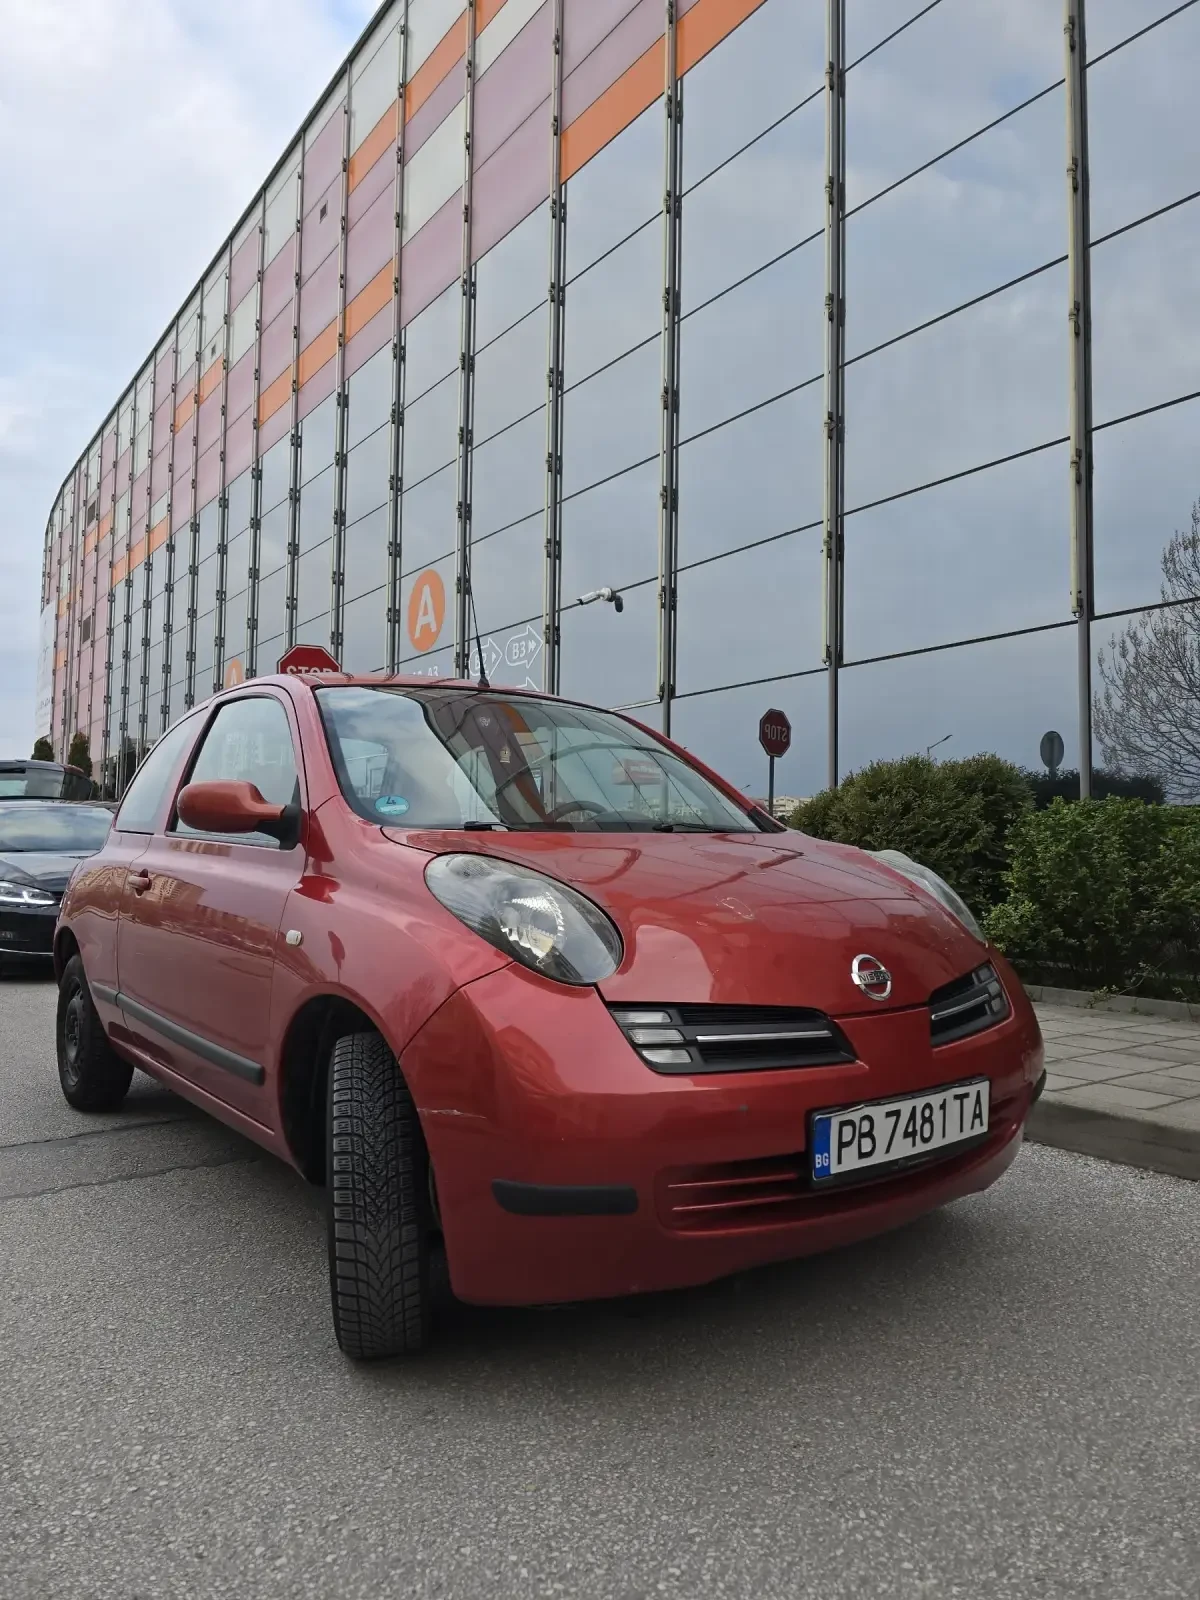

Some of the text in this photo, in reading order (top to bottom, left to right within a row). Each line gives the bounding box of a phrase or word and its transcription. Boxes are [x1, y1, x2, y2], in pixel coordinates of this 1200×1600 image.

[414, 583, 438, 640] A
[512, 640, 526, 660] B3
[837, 1089, 984, 1166] PB 7481 TA
[815, 1152, 829, 1169] BG
